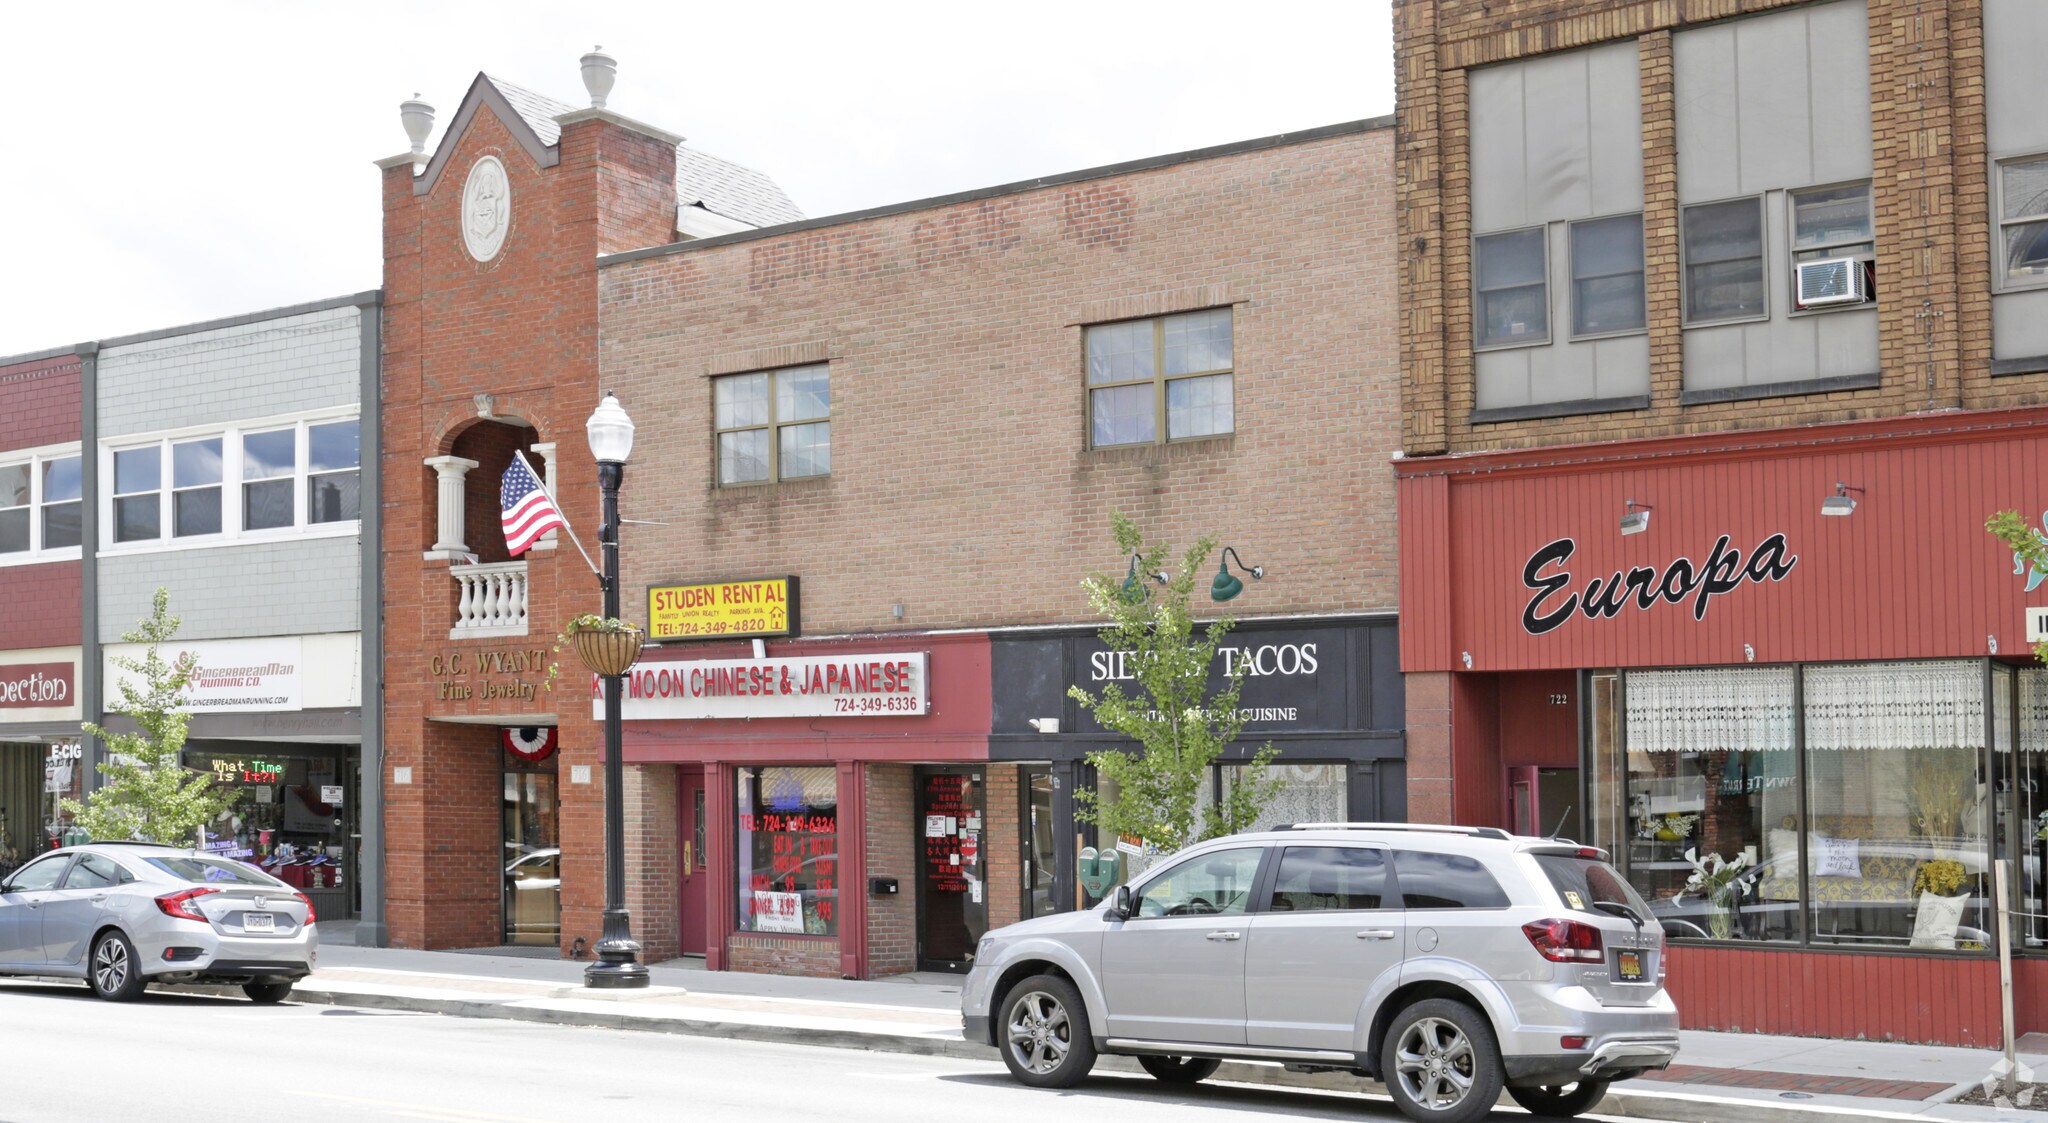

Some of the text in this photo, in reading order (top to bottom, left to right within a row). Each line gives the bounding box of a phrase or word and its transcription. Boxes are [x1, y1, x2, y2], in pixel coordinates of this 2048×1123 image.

[1522, 533, 1797, 635] Europa
[656, 583, 785, 611] STUDEN RENTAL
[475, 649, 546, 674] WYANT
[1218, 643, 1318, 677] TACOS
[200, 677, 244, 688] RUNNING
[629, 668, 685, 699] MOON
[690, 665, 775, 698] CHINESE
[780, 664, 792, 695] &
[800, 661, 910, 694] JAPANESE
[440, 679, 537, 702] Fine Jewelry
[1550, 694, 1568, 704] 722
[834, 697, 917, 712] 724-349-6336
[51, 744, 82, 759] E-CIG
[212, 760, 282, 773] What Time
[218, 771, 276, 783] Is It?!
[740, 814, 760, 831] TEL:
